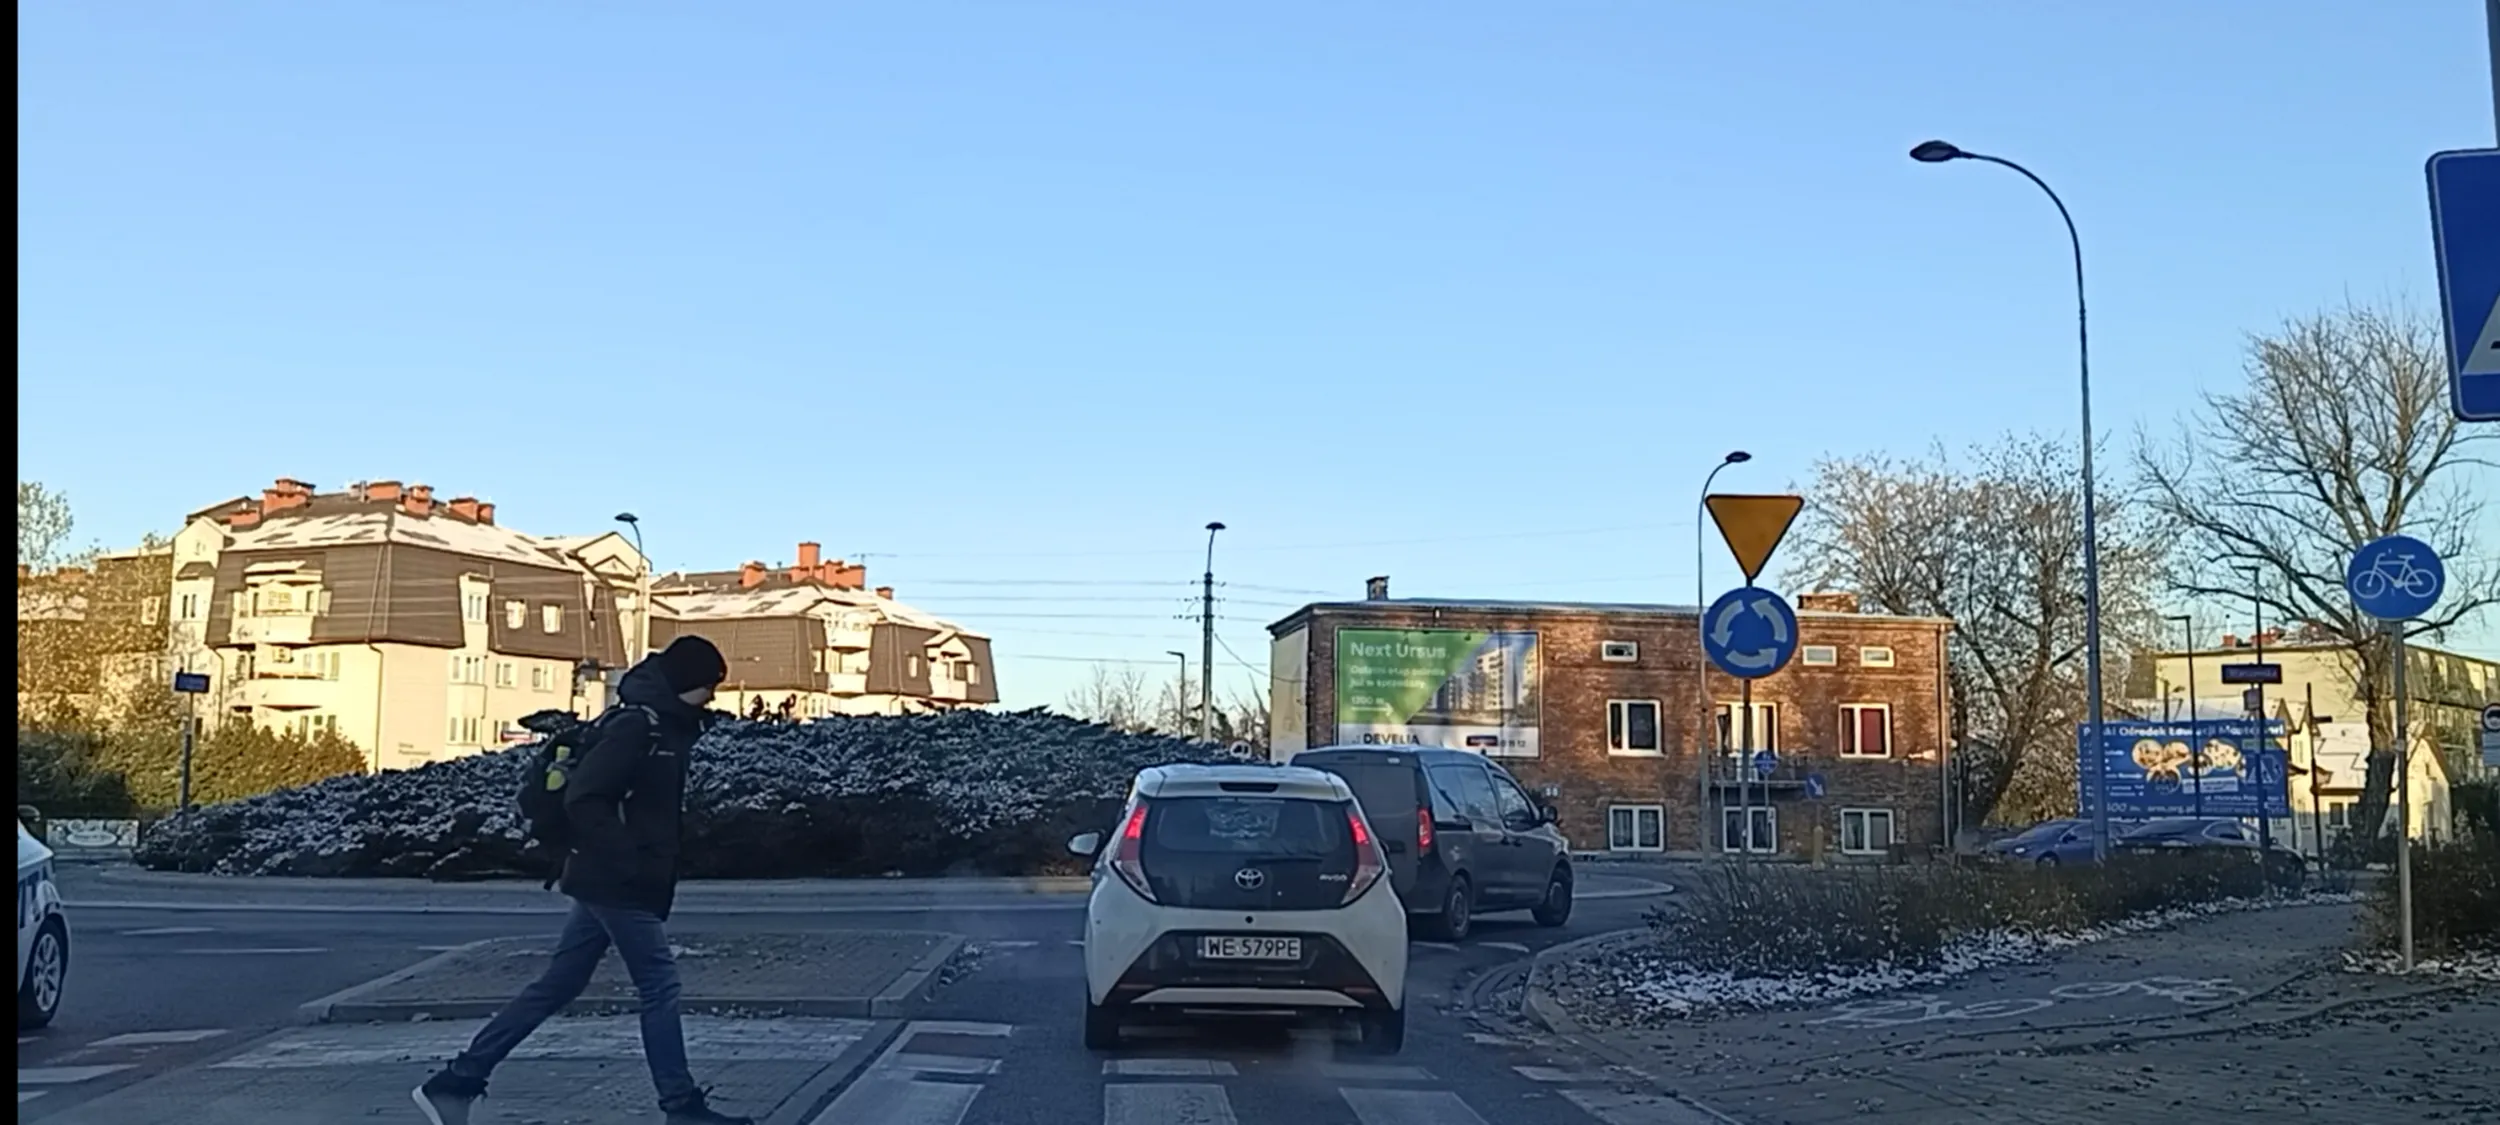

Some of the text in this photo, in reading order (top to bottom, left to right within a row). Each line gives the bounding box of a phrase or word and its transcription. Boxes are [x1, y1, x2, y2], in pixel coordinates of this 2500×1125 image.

[1350, 642, 1446, 658] Next Ursus
[1363, 733, 1420, 745] DEVELIA
[1208, 938, 1298, 957] WE 579PE
